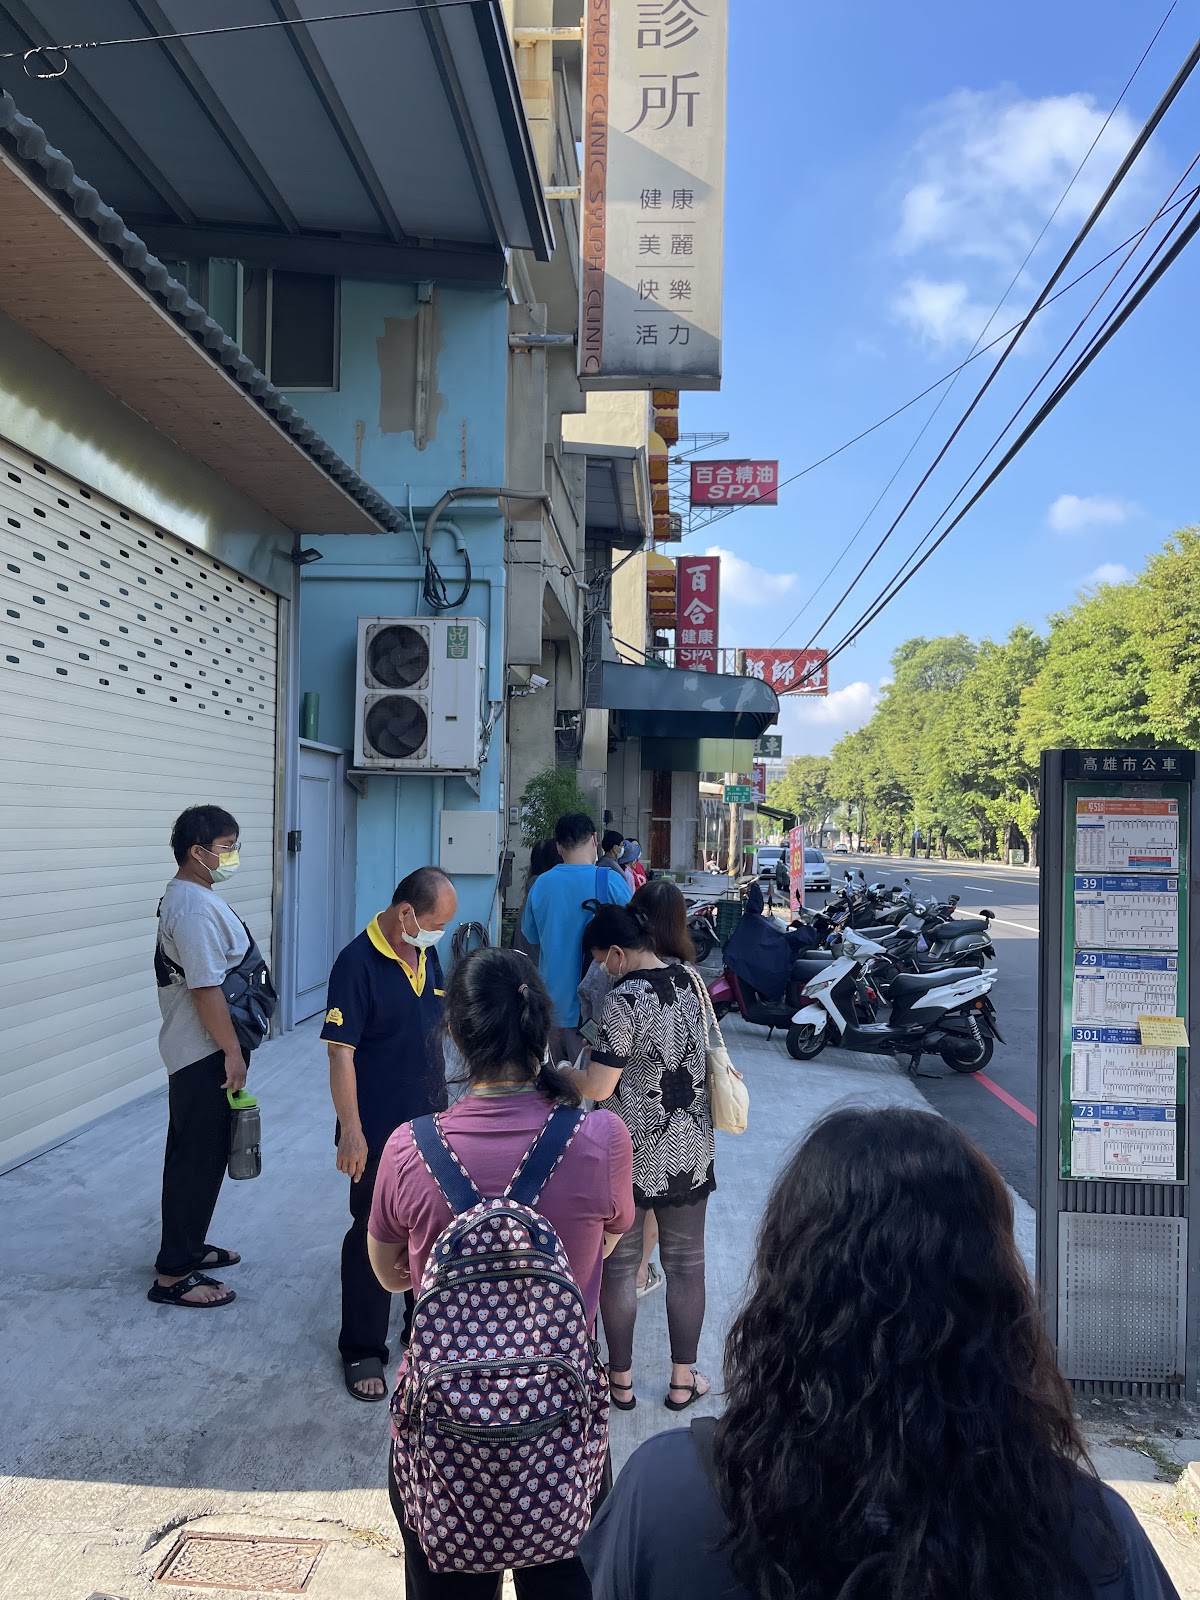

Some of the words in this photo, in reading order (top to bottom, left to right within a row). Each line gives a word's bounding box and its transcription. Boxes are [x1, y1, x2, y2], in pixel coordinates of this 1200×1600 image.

[593, 0, 607, 75] SYLPH
[623, 0, 709, 134] 診所
[591, 93, 606, 172] CLINIC
[640, 188, 695, 211] 健康
[588, 190, 604, 271] SYLPH
[638, 233, 694, 256] 美麗
[637, 278, 692, 301] 快樂
[585, 289, 601, 368] CLINIC
[636, 323, 691, 346] 活力
[696, 465, 775, 484] 百合精油
[707, 484, 761, 499] SPA
[683, 564, 714, 625] 百合
[681, 629, 714, 645] 健康
[680, 649, 714, 661] SPA
[1083, 756, 1177, 771] 高雄市公車
[1082, 878, 1097, 889] 39
[1082, 954, 1097, 965] 29
[1076, 1029, 1099, 1041] 301
[1079, 1106, 1094, 1117] 73
